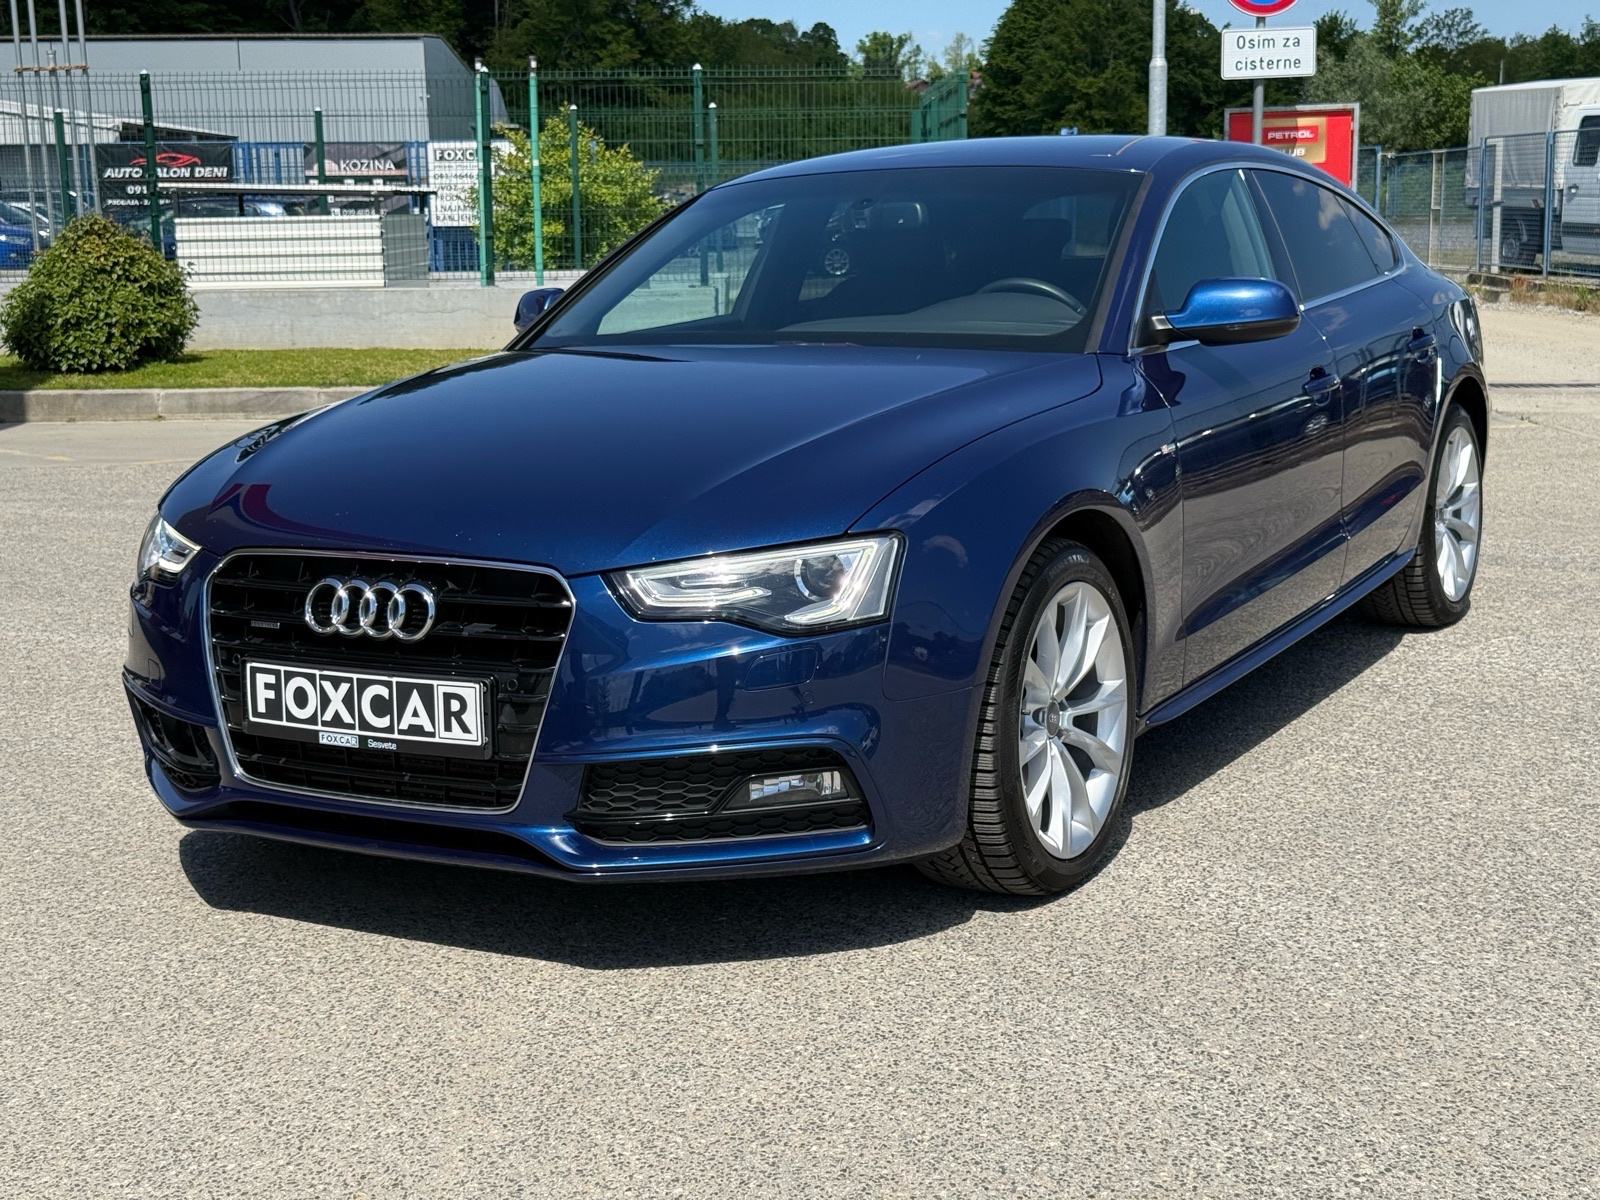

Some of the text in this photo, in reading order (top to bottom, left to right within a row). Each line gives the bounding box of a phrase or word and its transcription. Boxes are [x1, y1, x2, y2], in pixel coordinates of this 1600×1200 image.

[1236, 35, 1301, 50] Osim za
[1235, 57, 1301, 71] cisterne
[1267, 129, 1315, 140] PETROL
[435, 150, 475, 161] FOXC
[340, 159, 396, 172] KOZINA
[104, 167, 228, 178] AUTO ALON DENI
[255, 672, 474, 736] FOXCAR
[320, 734, 398, 751] FOXCAR Sesvete
